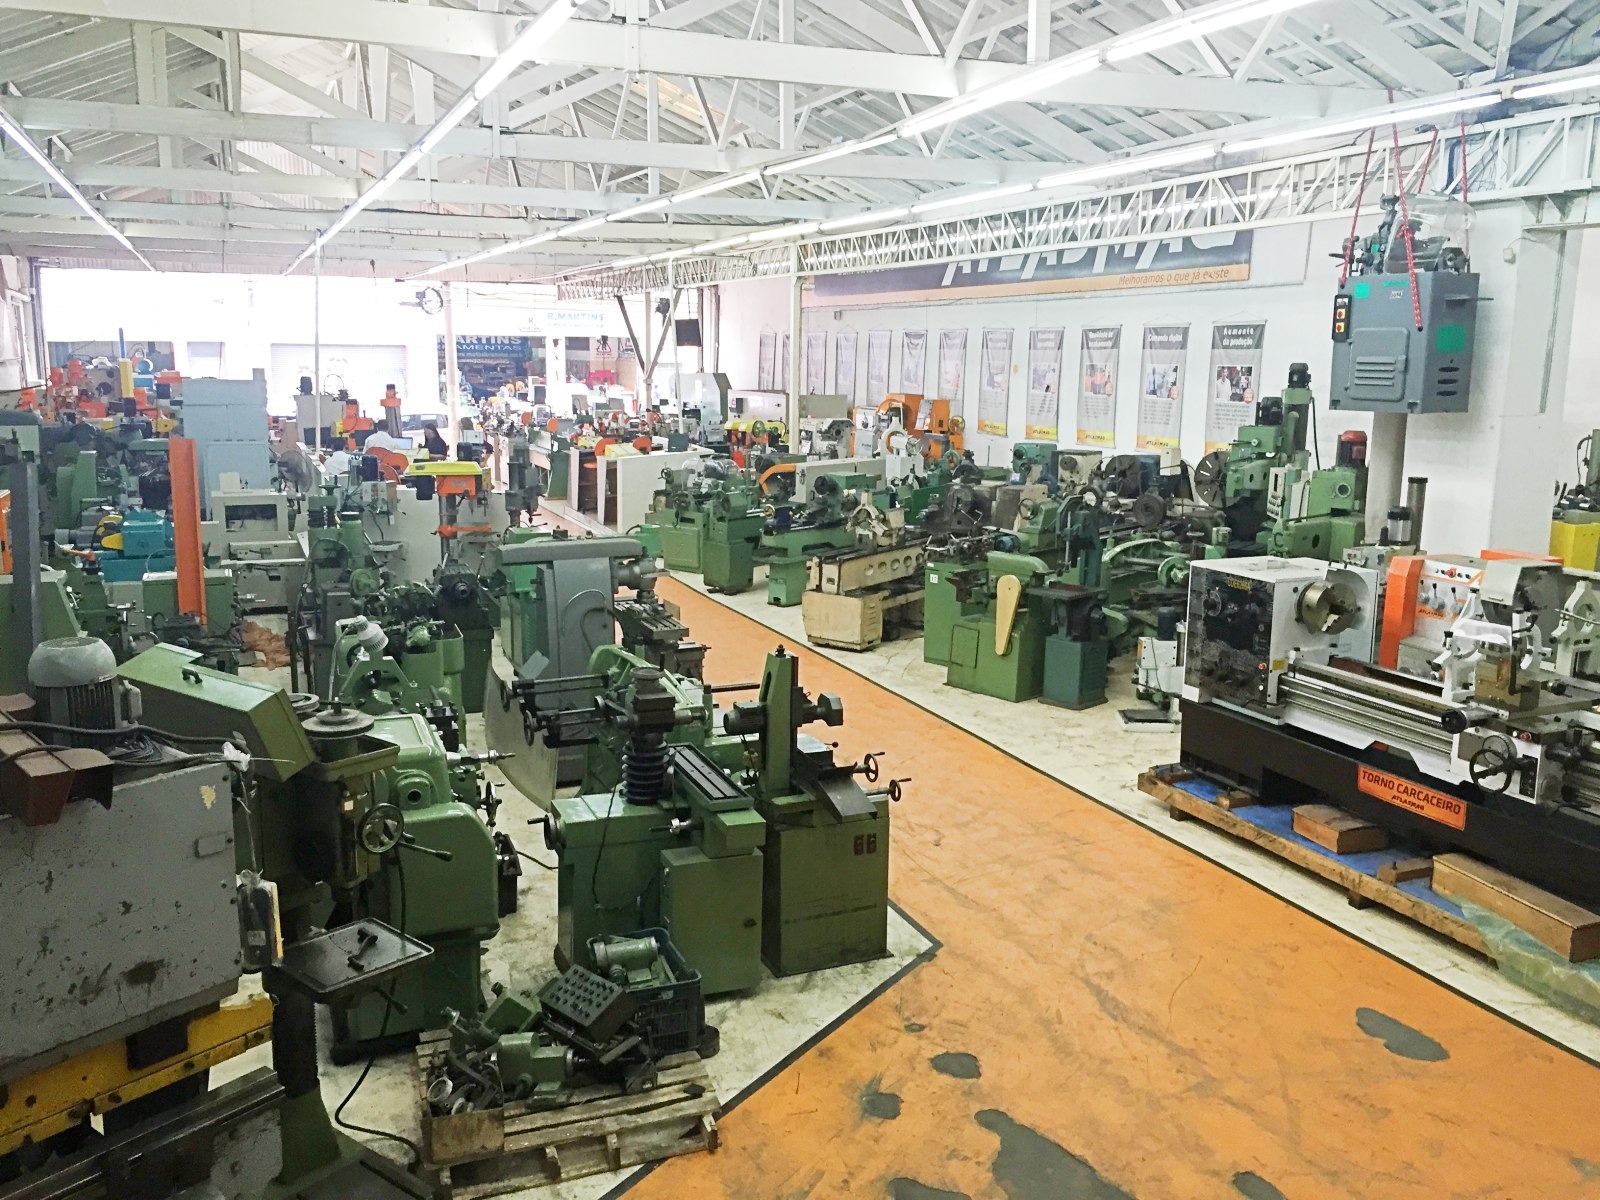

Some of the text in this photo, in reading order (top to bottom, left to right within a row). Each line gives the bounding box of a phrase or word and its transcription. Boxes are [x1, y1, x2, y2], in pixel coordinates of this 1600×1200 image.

[1166, 274, 1172, 282] o
[1174, 273, 1189, 284] que
[1191, 269, 1201, 284] já
[1203, 268, 1229, 280] existe
[1223, 337, 1253, 347] da produção
[1362, 770, 1461, 815] TORNO CARCACEIRO
